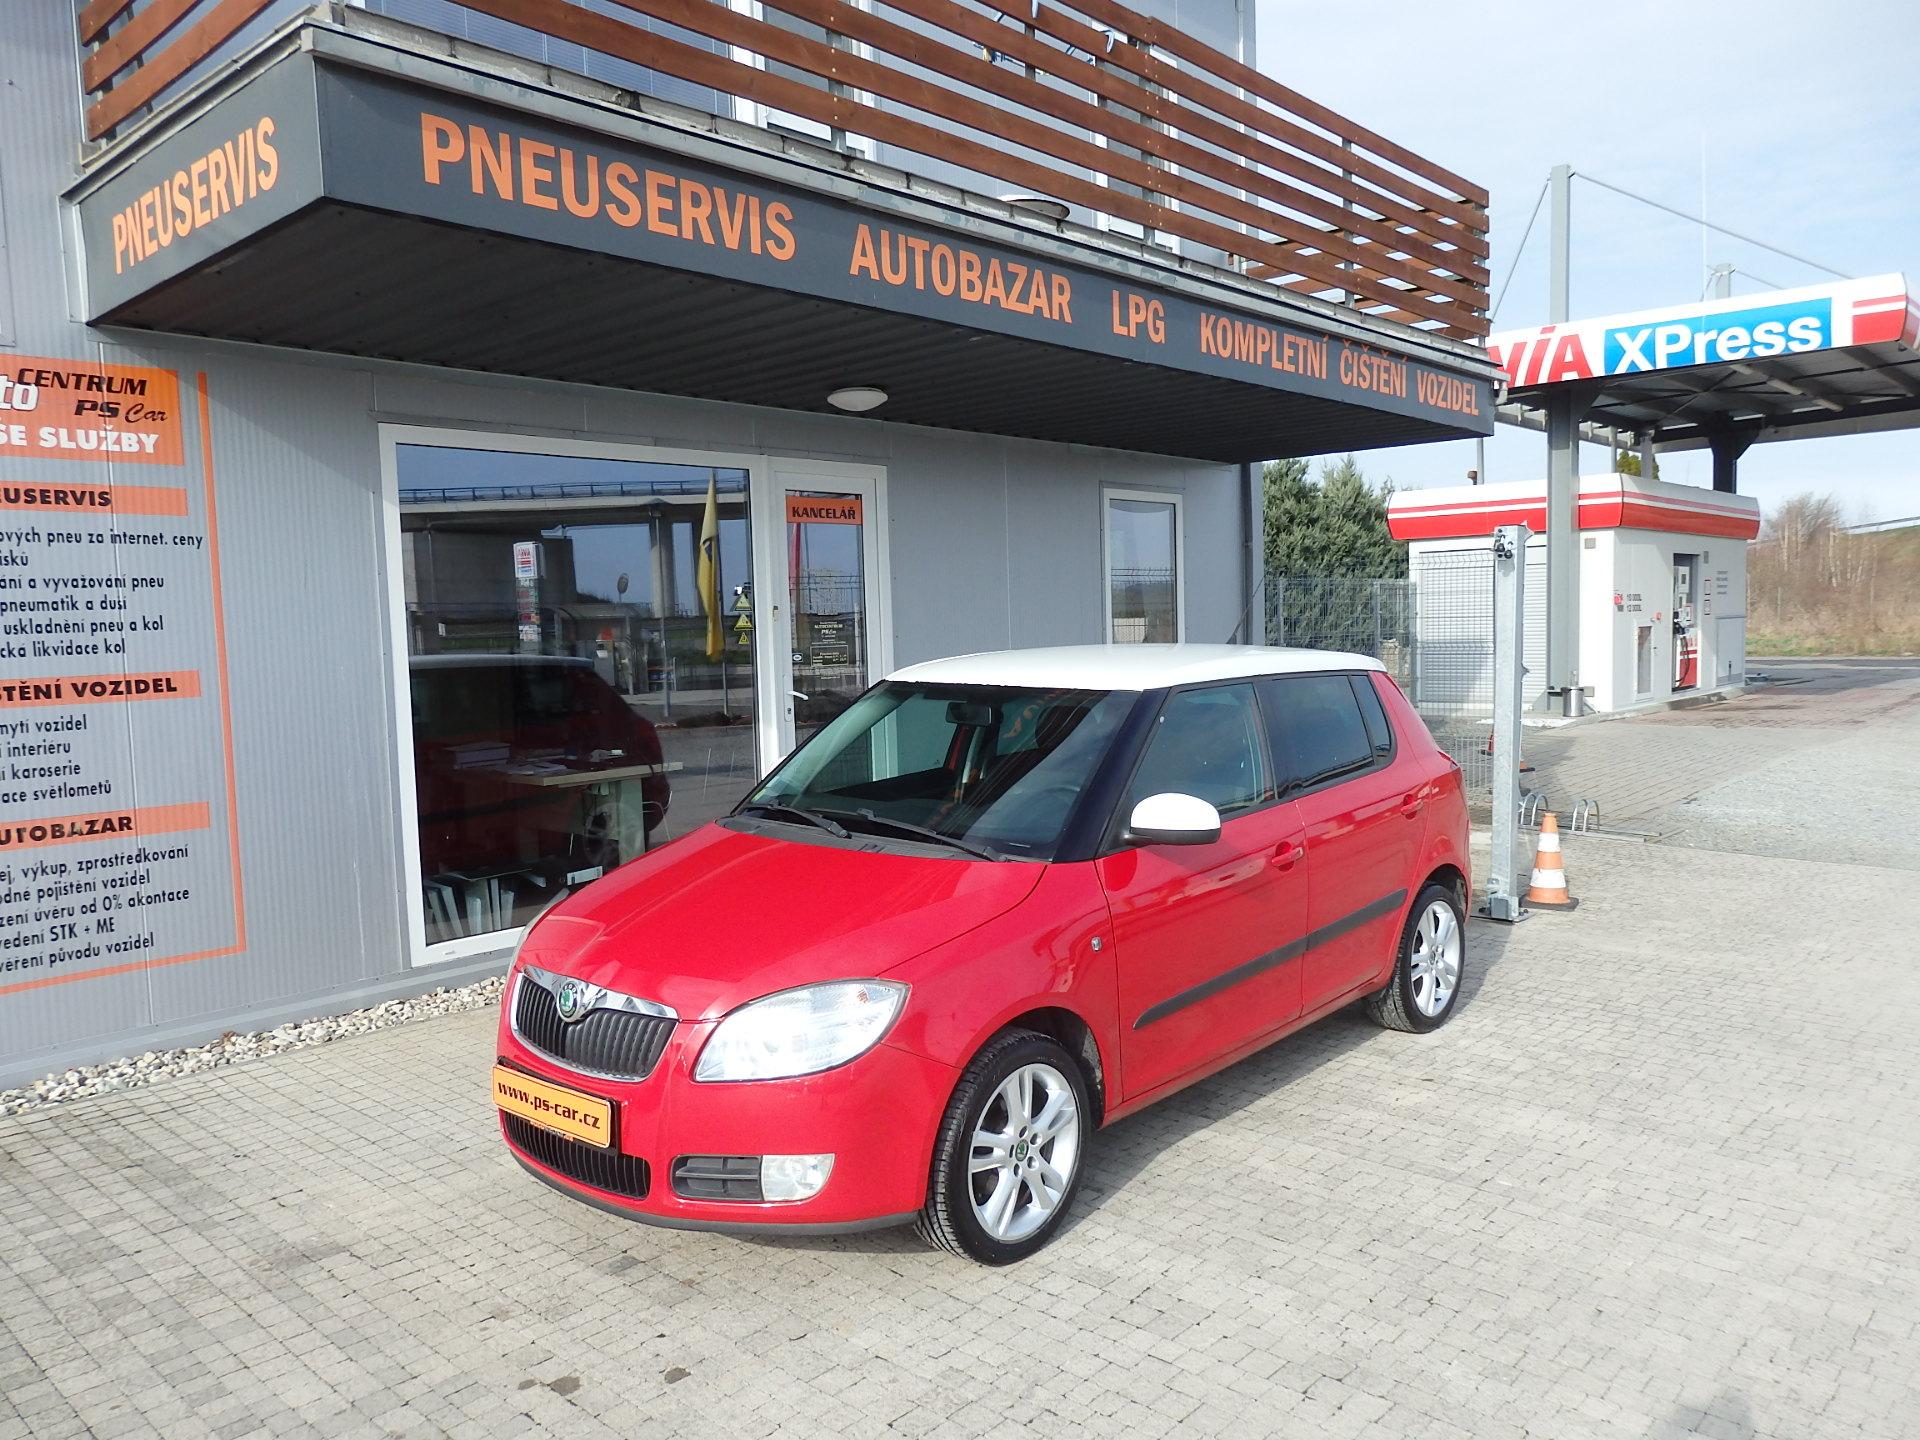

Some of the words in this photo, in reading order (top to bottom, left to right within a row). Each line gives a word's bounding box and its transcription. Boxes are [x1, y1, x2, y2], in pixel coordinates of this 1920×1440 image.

[112, 116, 278, 274] PNEUSERVIS
[421, 112, 796, 261] PNEUSERVIS
[850, 223, 1072, 323] AUTOBAZAR
[1112, 289, 1166, 344] LPG
[1200, 312, 1330, 379] KOMPLETNÍ
[1339, 338, 1408, 398] ČIŠTĚNÍ
[1416, 369, 1479, 416] VOZIDEL
[1613, 315, 1822, 373] XPress
[18, 368, 147, 396] CENTRUM
[75, 400, 121, 418] PS
[125, 403, 168, 423] Car
[39, 424, 159, 453] SLUŽBY
[0, 487, 111, 506] USERVIS
[792, 506, 856, 519] KANCELÁŘ
[47, 532, 82, 547] pneu
[88, 533, 104, 543] za
[110, 528, 168, 545] internet.
[172, 535, 203, 549] ceny
[28, 578, 36, 588] a
[43, 574, 126, 593] vyvažování
[132, 577, 164, 592] pneu
[0, 594, 79, 616] pneumatik
[86, 600, 94, 610] a
[4, 617, 85, 635] uskladnění
[90, 620, 124, 636] pneu
[129, 621, 137, 631] a
[143, 614, 164, 631] kol
[33, 639, 99, 657] likvidace
[104, 637, 126, 653] kol
[0, 678, 62, 701] TĚNÍ
[71, 677, 177, 698] VOZIDEL
[36, 713, 87, 732] vozidel
[7, 739, 71, 758] interiéru
[11, 760, 81, 779] karoserie
[2, 791, 27, 803] ace
[33, 780, 112, 800] světlometů
[21, 860, 71, 882] výkup,
[77, 844, 188, 875] zprostředkování
[37, 877, 97, 903] pojištění
[101, 868, 151, 890] vozidel
[34, 907, 75, 922] úvěru
[80, 898, 97, 915] od
[103, 894, 123, 911] 0%
[128, 889, 190, 907] akontace
[50, 922, 78, 942] STK
[96, 917, 115, 934] ME
[49, 942, 100, 968] původu
[106, 932, 154, 954] vozidel
[498, 1082, 601, 1130] www.ps-car.cz
